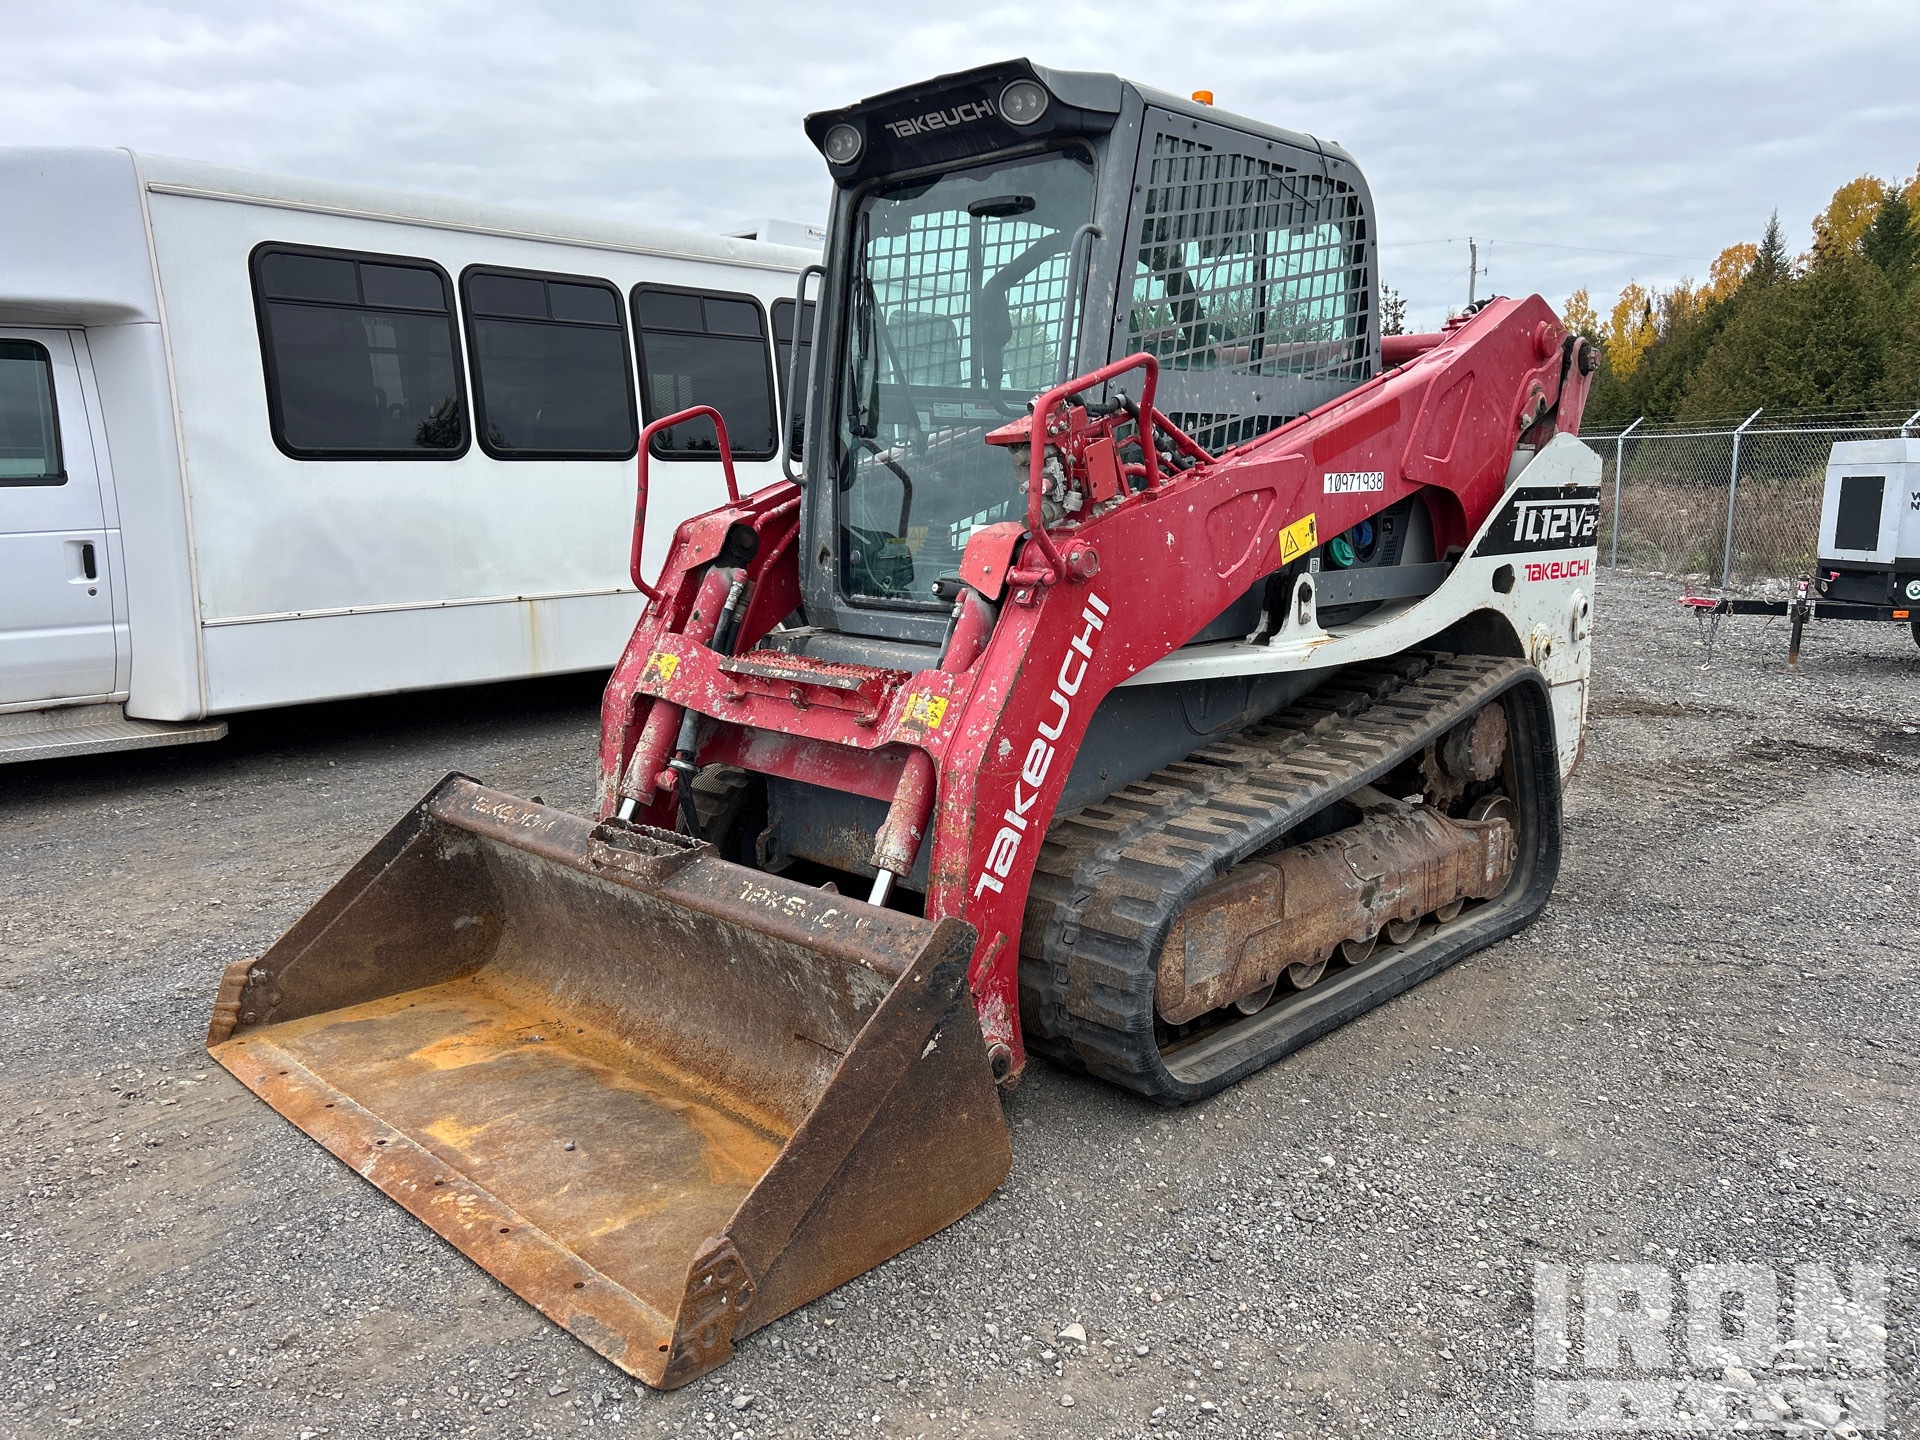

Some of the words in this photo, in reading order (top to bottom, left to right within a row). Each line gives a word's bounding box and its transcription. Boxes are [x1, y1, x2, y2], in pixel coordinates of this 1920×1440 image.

[884, 98, 997, 138] TAKEUCHI
[1328, 472, 1383, 492] 10971938
[1524, 559, 1590, 582] TAKEUCHI
[973, 591, 1110, 902] TAKEUCHI
